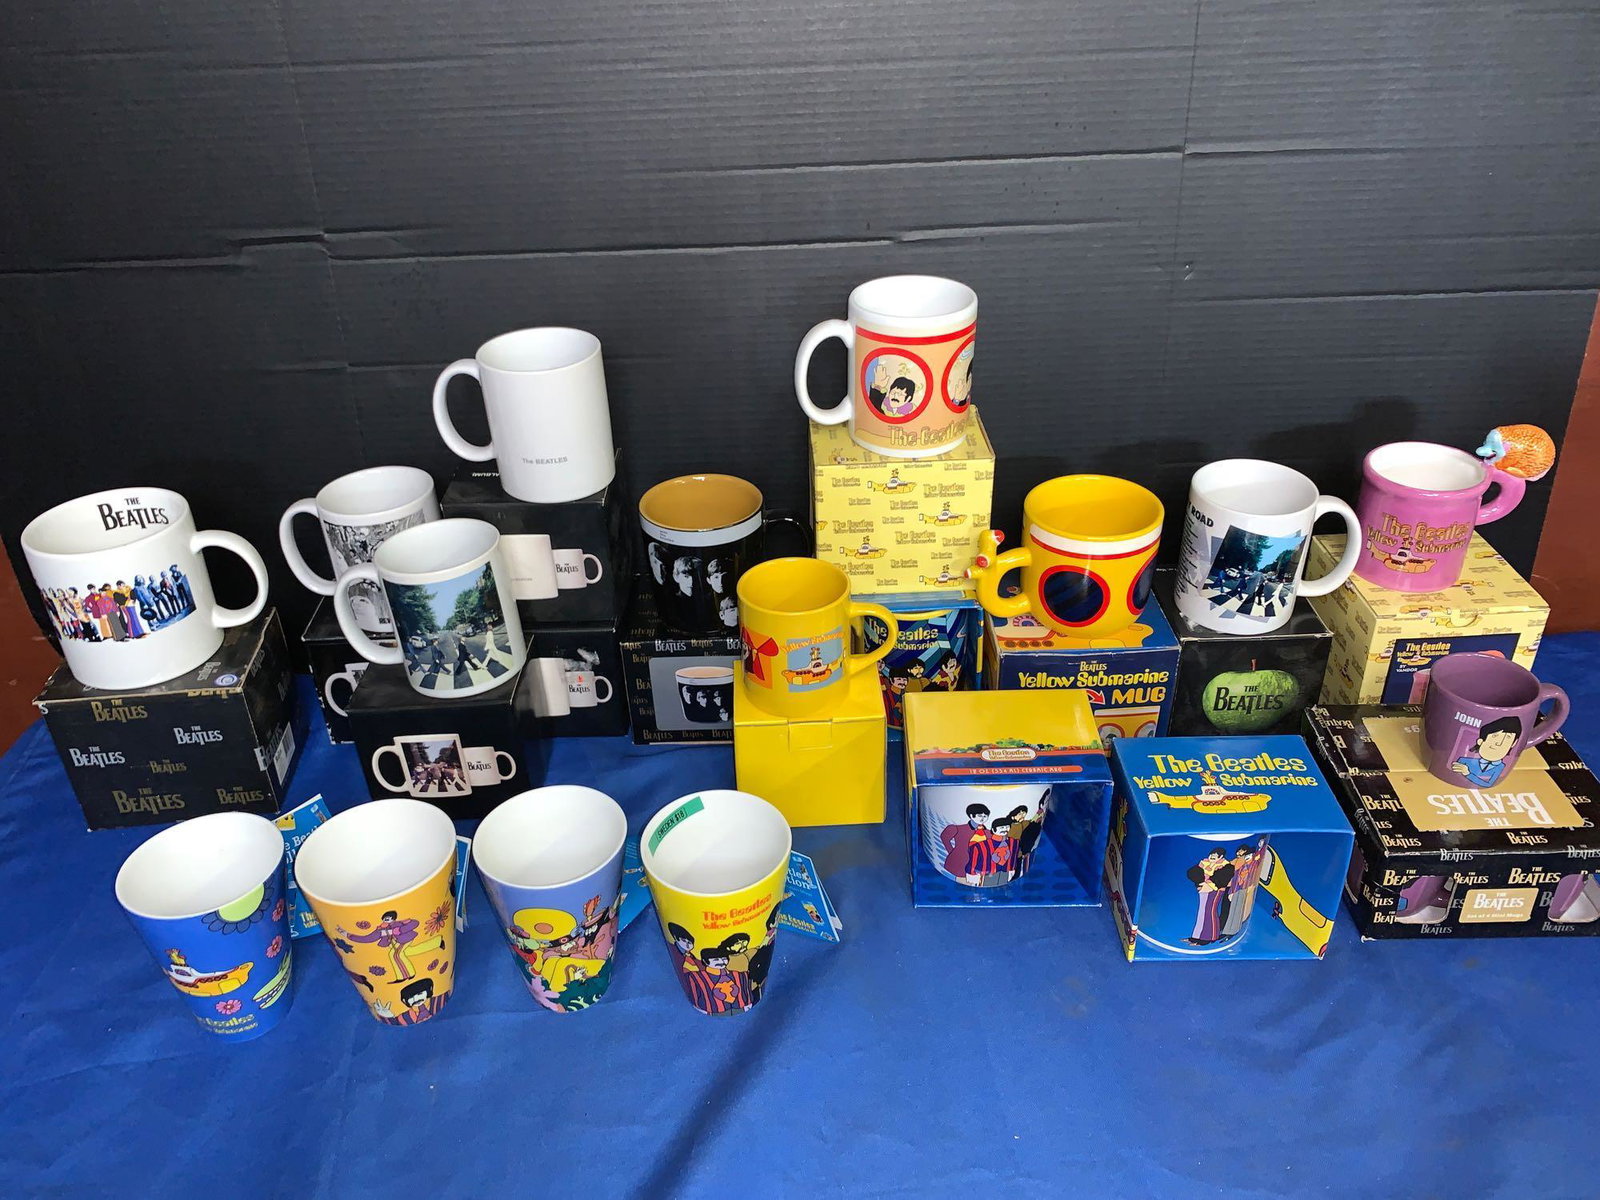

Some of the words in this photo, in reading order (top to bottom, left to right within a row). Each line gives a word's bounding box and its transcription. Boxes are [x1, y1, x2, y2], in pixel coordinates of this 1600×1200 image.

[888, 425, 917, 446] The
[535, 456, 568, 465] BEATLES
[124, 497, 140, 505] THE
[97, 503, 169, 531] BEATLES
[1191, 506, 1214, 527] ROAD
[1382, 512, 1412, 538] The
[898, 627, 938, 641] eatles
[655, 640, 686, 653] BEATLES
[1080, 661, 1107, 672] BEATLES
[1018, 672, 1075, 688] Yellow
[1076, 669, 1169, 688] Submarine
[1111, 686, 1166, 705] MUG
[1244, 685, 1258, 693] THE
[1213, 686, 1284, 714] BEATLES
[91, 701, 148, 723] BEATLES
[1454, 711, 1482, 728] JOHN
[173, 727, 224, 746] BEATLES
[69, 748, 126, 768] BEATLES
[467, 761, 492, 771] BEATLES
[1148, 754, 1202, 773] The
[1205, 753, 1307, 772] Beatles
[149, 761, 187, 774] BEATLES
[1133, 776, 1193, 789] Yellow
[1219, 773, 1318, 787] Submarine
[112, 790, 185, 815] BEATLES
[216, 788, 264, 805] BEATLES
[1362, 795, 1403, 812] BEATL
[1427, 789, 1555, 825] BEATLES
[657, 818, 675, 838] SWEDEN
[1488, 817, 1512, 827] THE
[1382, 834, 1422, 848] BEATLES
[1506, 832, 1548, 845] BEATLES
[1440, 848, 1474, 862] BEATLES
[1567, 845, 1600, 860] BEATLES
[1453, 872, 1489, 886] BEATLES
[1508, 867, 1562, 886] BEATLES
[1474, 893, 1524, 911] BEATLES
[702, 911, 726, 921] The
[1373, 912, 1398, 924] BEAT
[1420, 924, 1452, 935] BEATLES
[1542, 922, 1575, 932] BEATLES
